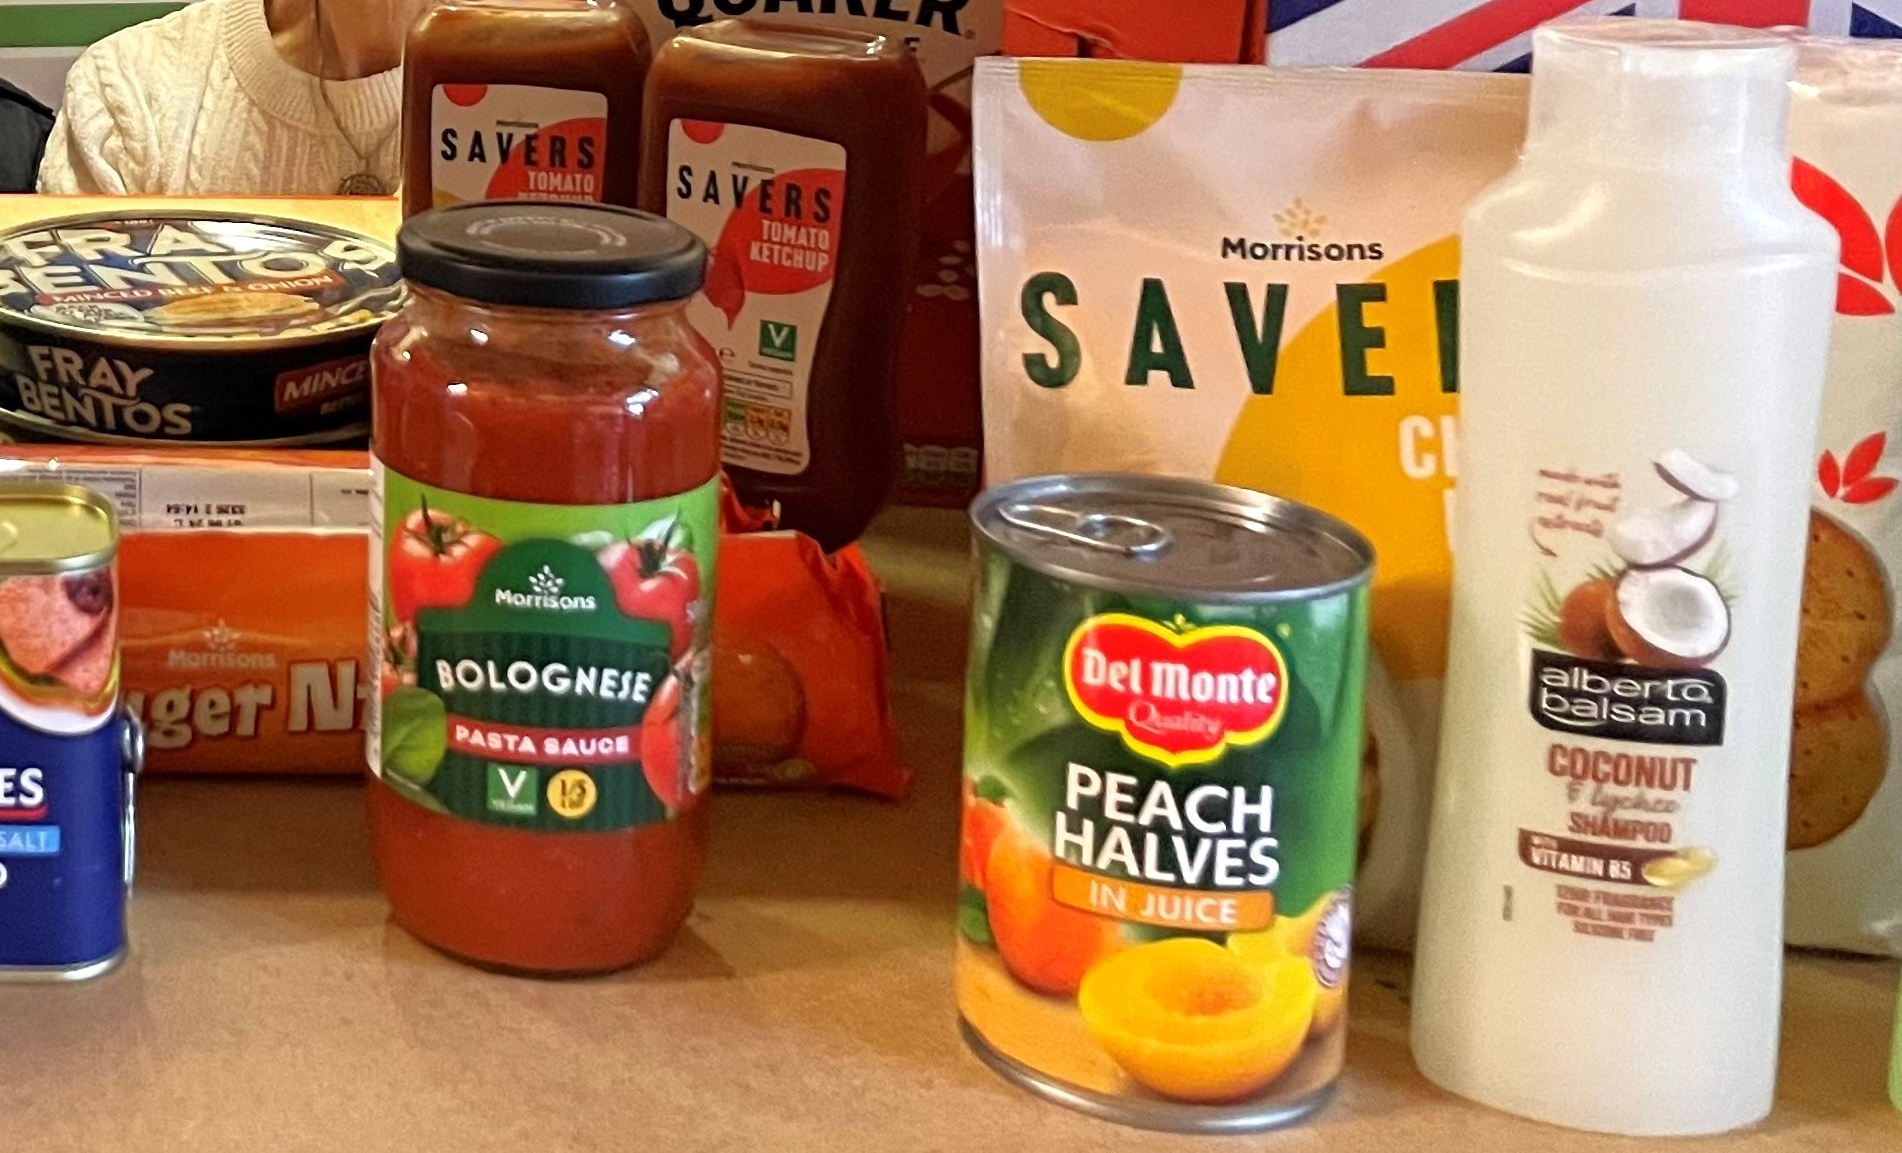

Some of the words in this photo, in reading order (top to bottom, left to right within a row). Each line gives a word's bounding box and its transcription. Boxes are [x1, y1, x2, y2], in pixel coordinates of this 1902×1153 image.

[440, 127, 596, 171] SAVERS
[528, 170, 595, 192] TOMATO
[676, 164, 833, 225] SAVERS
[761, 218, 830, 244] TOMATO
[1221, 235, 1384, 262] Morrisons
[749, 239, 830, 274] KETCHUP
[248, 275, 334, 292] ONION
[28, 346, 154, 397] FRAY
[15, 372, 193, 436] BENTOS
[494, 588, 597, 611] Morrisons
[166, 649, 276, 669] Morrisons
[1081, 647, 1142, 695] Del
[1149, 661, 1277, 704] Monte
[435, 659, 652, 704] BOLOGNESE
[1540, 666, 1715, 704] alberto
[1128, 700, 1222, 741] Quality
[1539, 687, 1707, 728] balsam
[455, 723, 537, 755] PASTA
[543, 735, 630, 756] SAUCE
[498, 767, 527, 799] V
[1548, 743, 1698, 792] COCONUT
[1065, 761, 1274, 834] PEACH
[1568, 811, 1673, 844] SHAMPOO
[1054, 810, 1281, 887] HALVES
[1531, 848, 1604, 877] VITAMIN
[1607, 859, 1632, 880] B5
[1089, 879, 1127, 913] IN
[1140, 895, 1238, 925] JUICE
